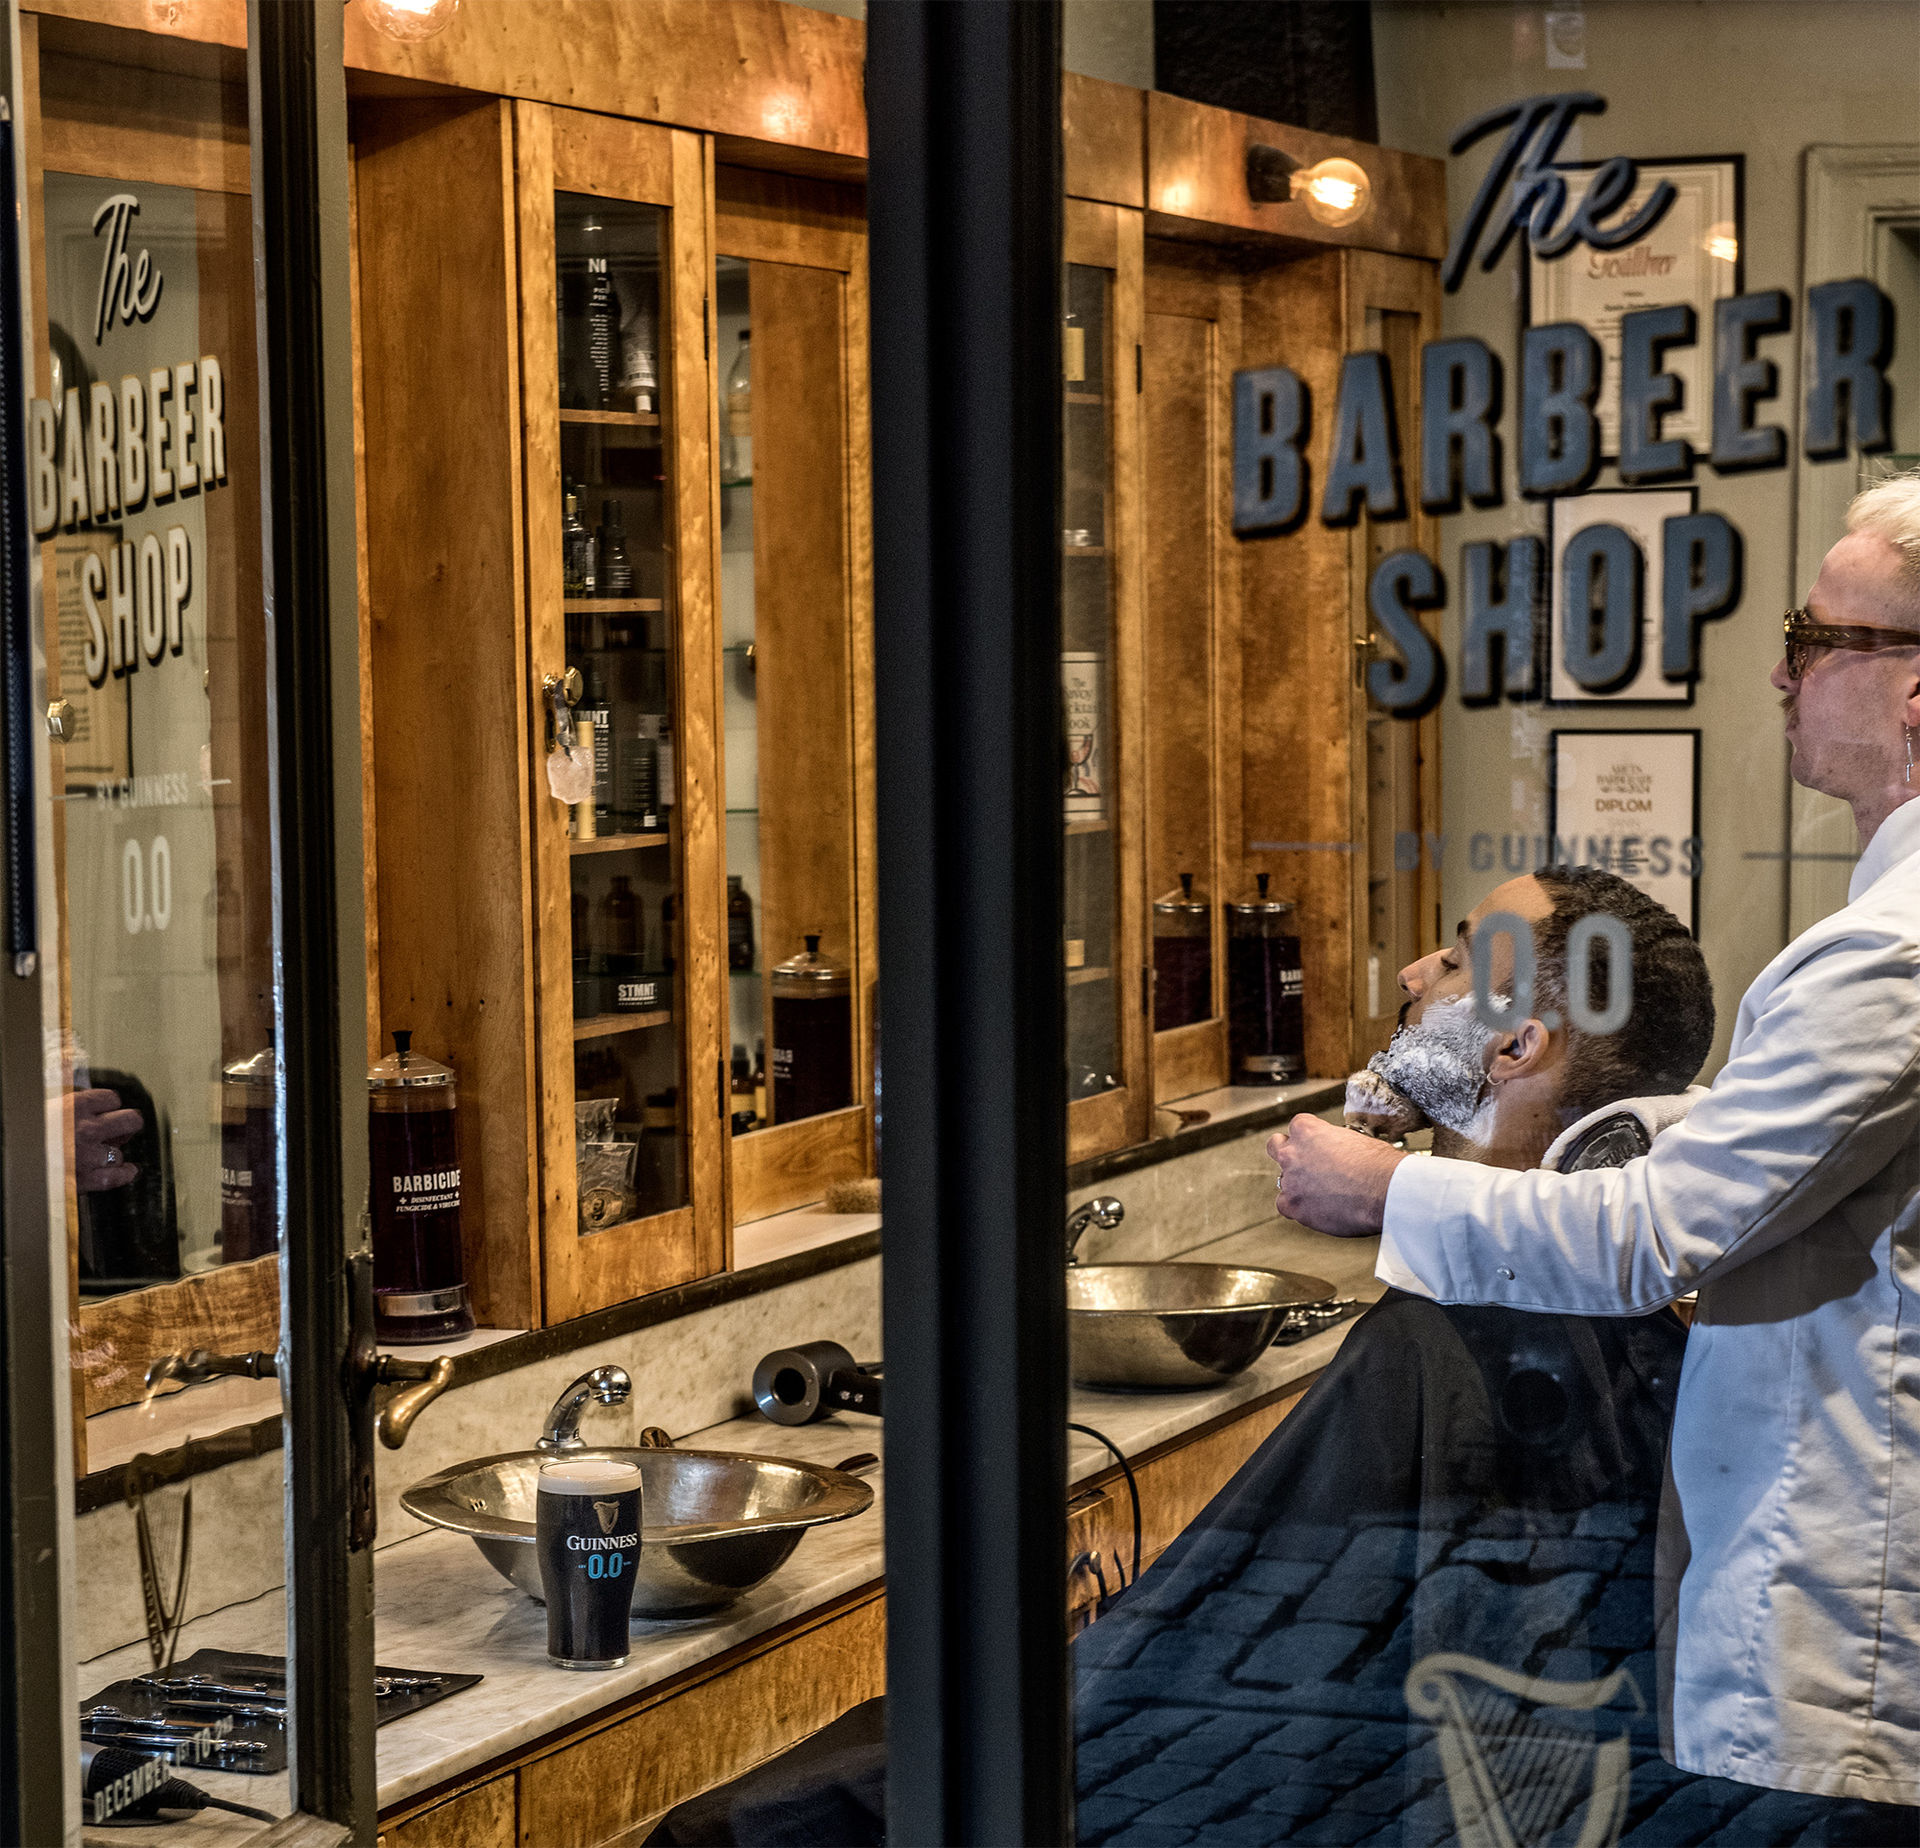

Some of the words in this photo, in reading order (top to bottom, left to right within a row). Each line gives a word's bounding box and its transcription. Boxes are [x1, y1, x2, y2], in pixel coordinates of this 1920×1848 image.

[1440, 91, 1679, 295] The
[92, 194, 163, 346] The
[30, 354, 228, 543] BARBEER
[1231, 278, 1895, 541] BARBEER
[81, 525, 192, 688] SHOP
[1365, 511, 1744, 718] SHOP
[119, 772, 189, 809] GUINNESS
[1594, 798, 1652, 813] DIPLOM
[122, 834, 172, 935] 0.0
[1394, 831, 1445, 874] BY
[1468, 833, 1704, 880] GUINNESS
[618, 982, 655, 998] STMNT
[1471, 909, 1634, 1036] 0.0
[393, 1169, 461, 1193] BARBICIDE
[566, 1533, 638, 1551] GUINNESS
[588, 1552, 623, 1579] 0.0
[93, 1751, 171, 1825] DECEMBER
[193, 1727, 211, 1763] TO
